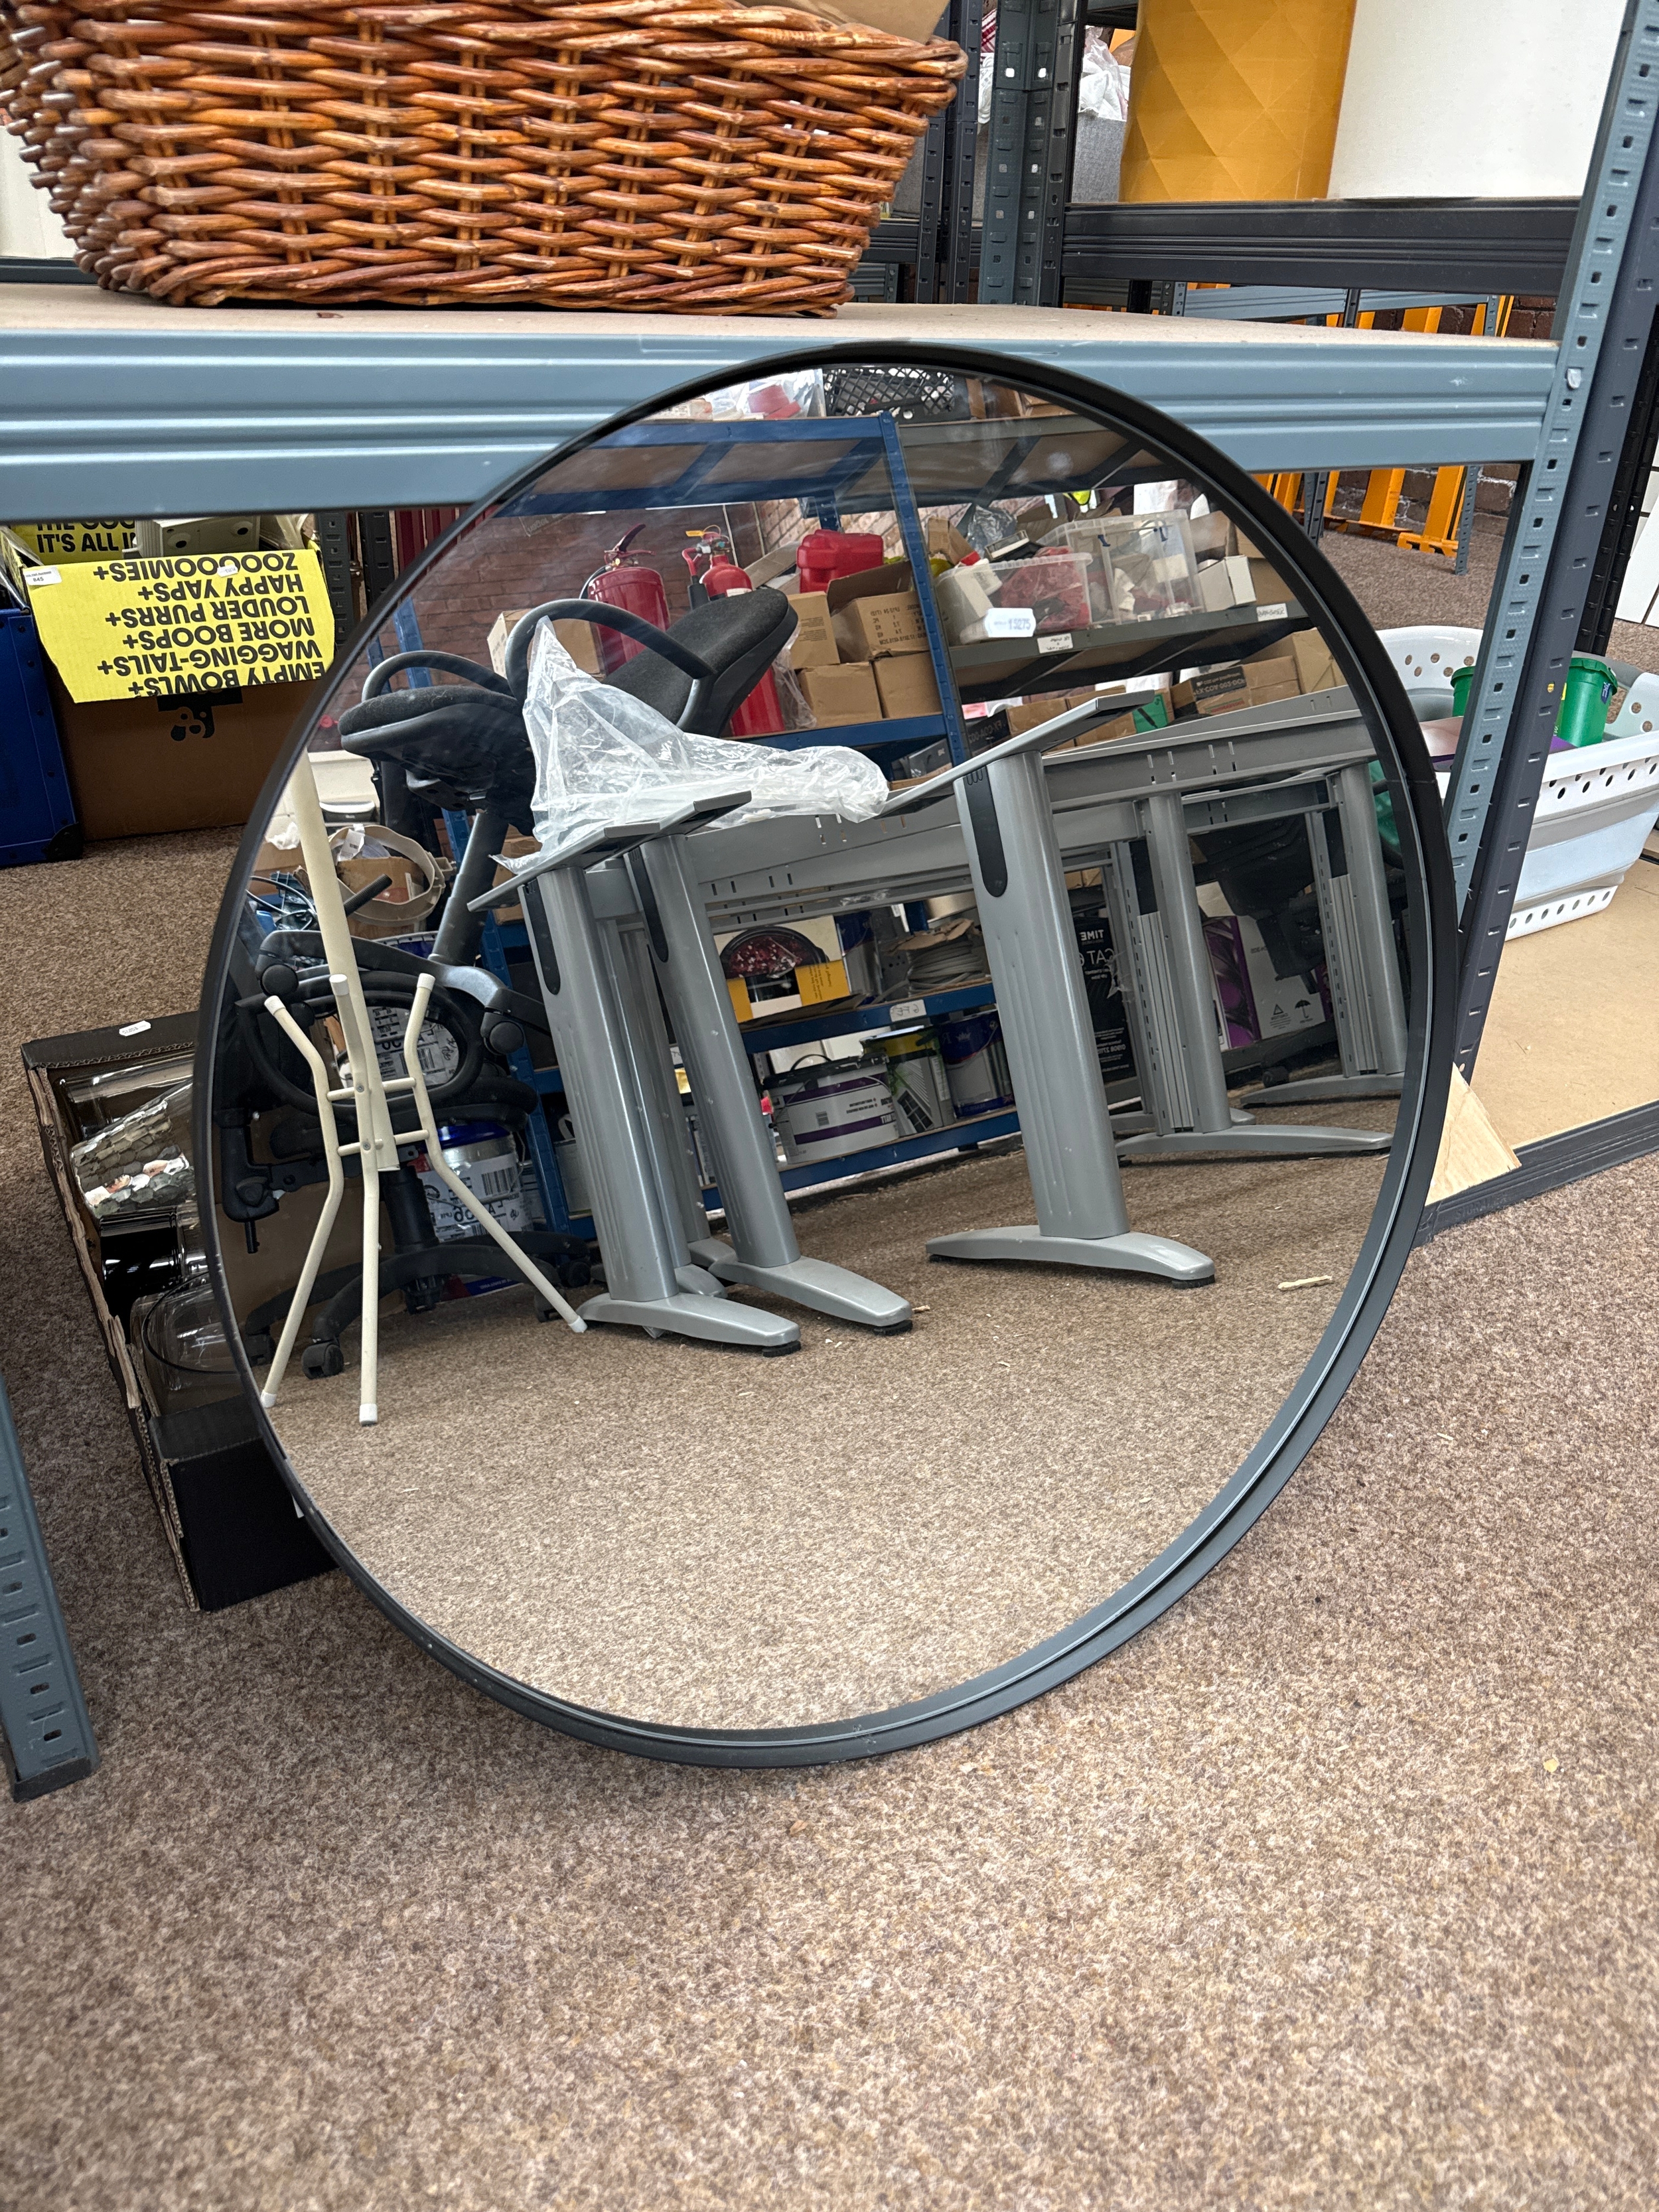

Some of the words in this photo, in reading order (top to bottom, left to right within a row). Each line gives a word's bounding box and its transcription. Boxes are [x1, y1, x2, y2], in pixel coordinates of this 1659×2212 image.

[36, 533, 76, 553] IT'S
[81, 532, 119, 552] ALL
[137, 579, 220, 602] YAPS+
[224, 573, 304, 598] HAPPY
[104, 602, 206, 628] PURRS+
[209, 595, 310, 621] LOUDER
[122, 623, 233, 650] BOOPS+
[237, 617, 316, 642] MORE
[1008, 619, 1031, 630] 15275
[97, 640, 323, 677] WAGGING-TAILS+
[248, 661, 325, 685] EMPTY
